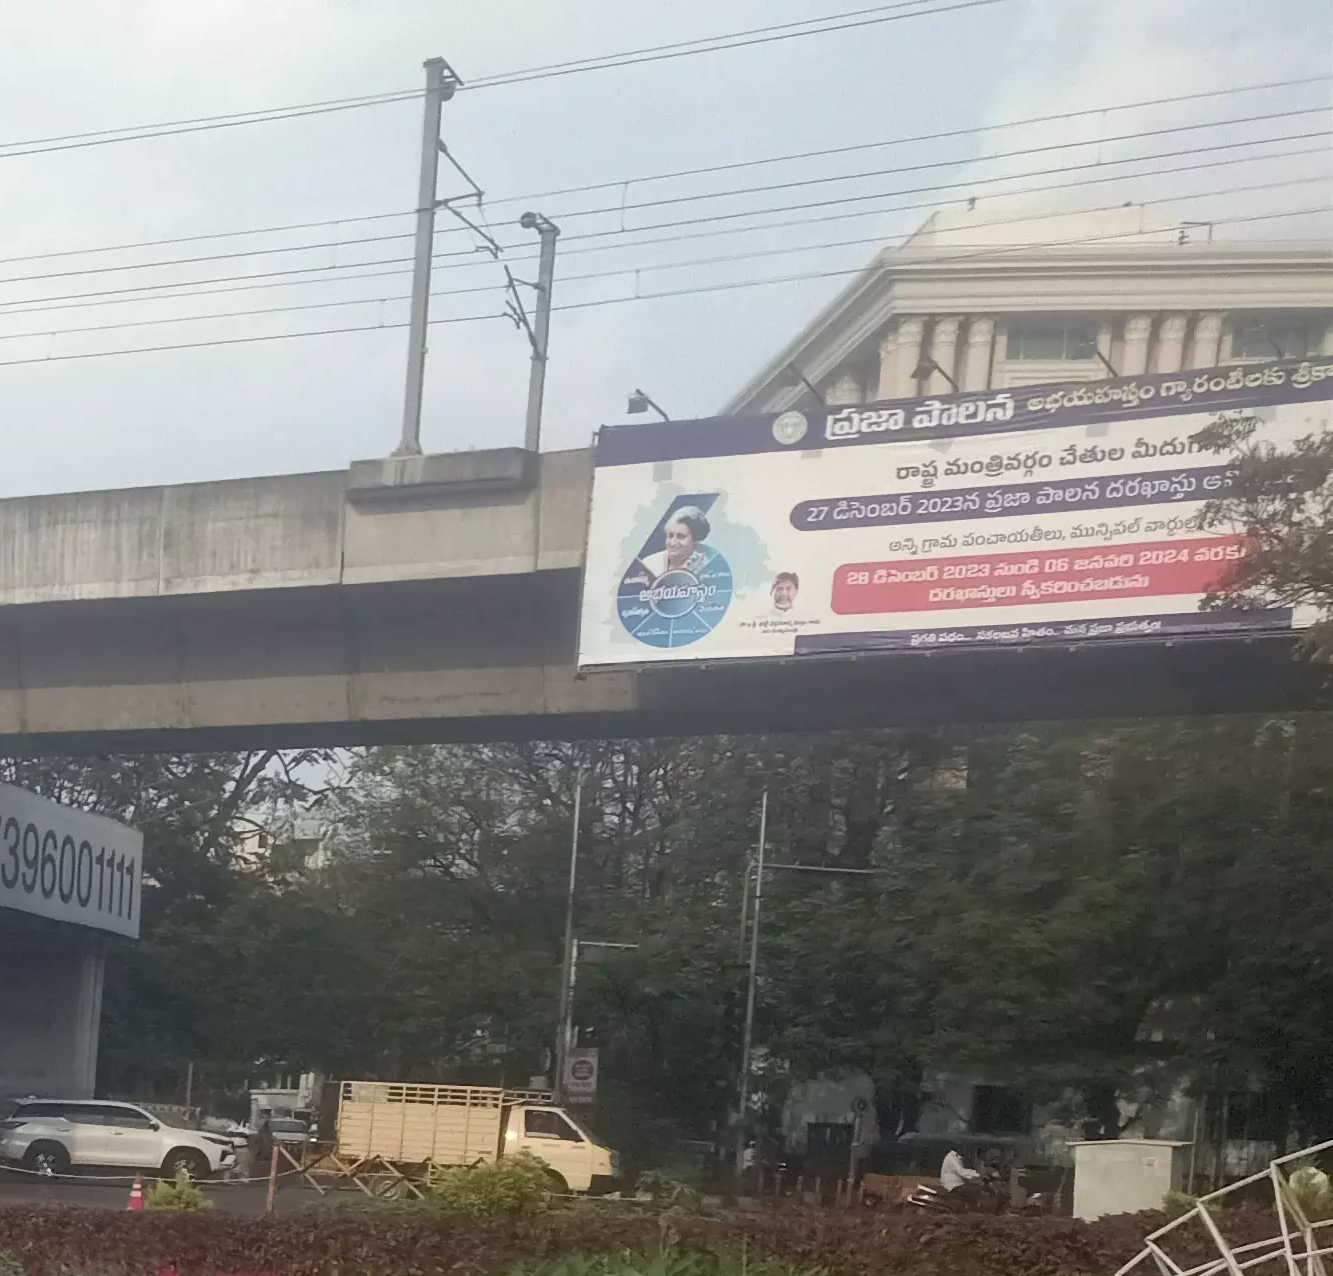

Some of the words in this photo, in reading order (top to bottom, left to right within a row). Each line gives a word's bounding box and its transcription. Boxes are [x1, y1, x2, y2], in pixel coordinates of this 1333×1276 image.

[824, 404, 904, 440] ప్రజా
[913, 393, 1015, 430] పాలన
[1059, 441, 1125, 464] చేతుల
[806, 506, 830, 522] 27
[833, 495, 913, 520] డిసెంబర్
[916, 492, 980, 514] 2023న
[984, 489, 1031, 512] ప్రజా
[1037, 482, 1100, 506] పాలన
[846, 571, 869, 585] 28
[943, 563, 990, 579] 2023
[1044, 557, 1069, 573] 06
[1138, 547, 1189, 565] 2024
